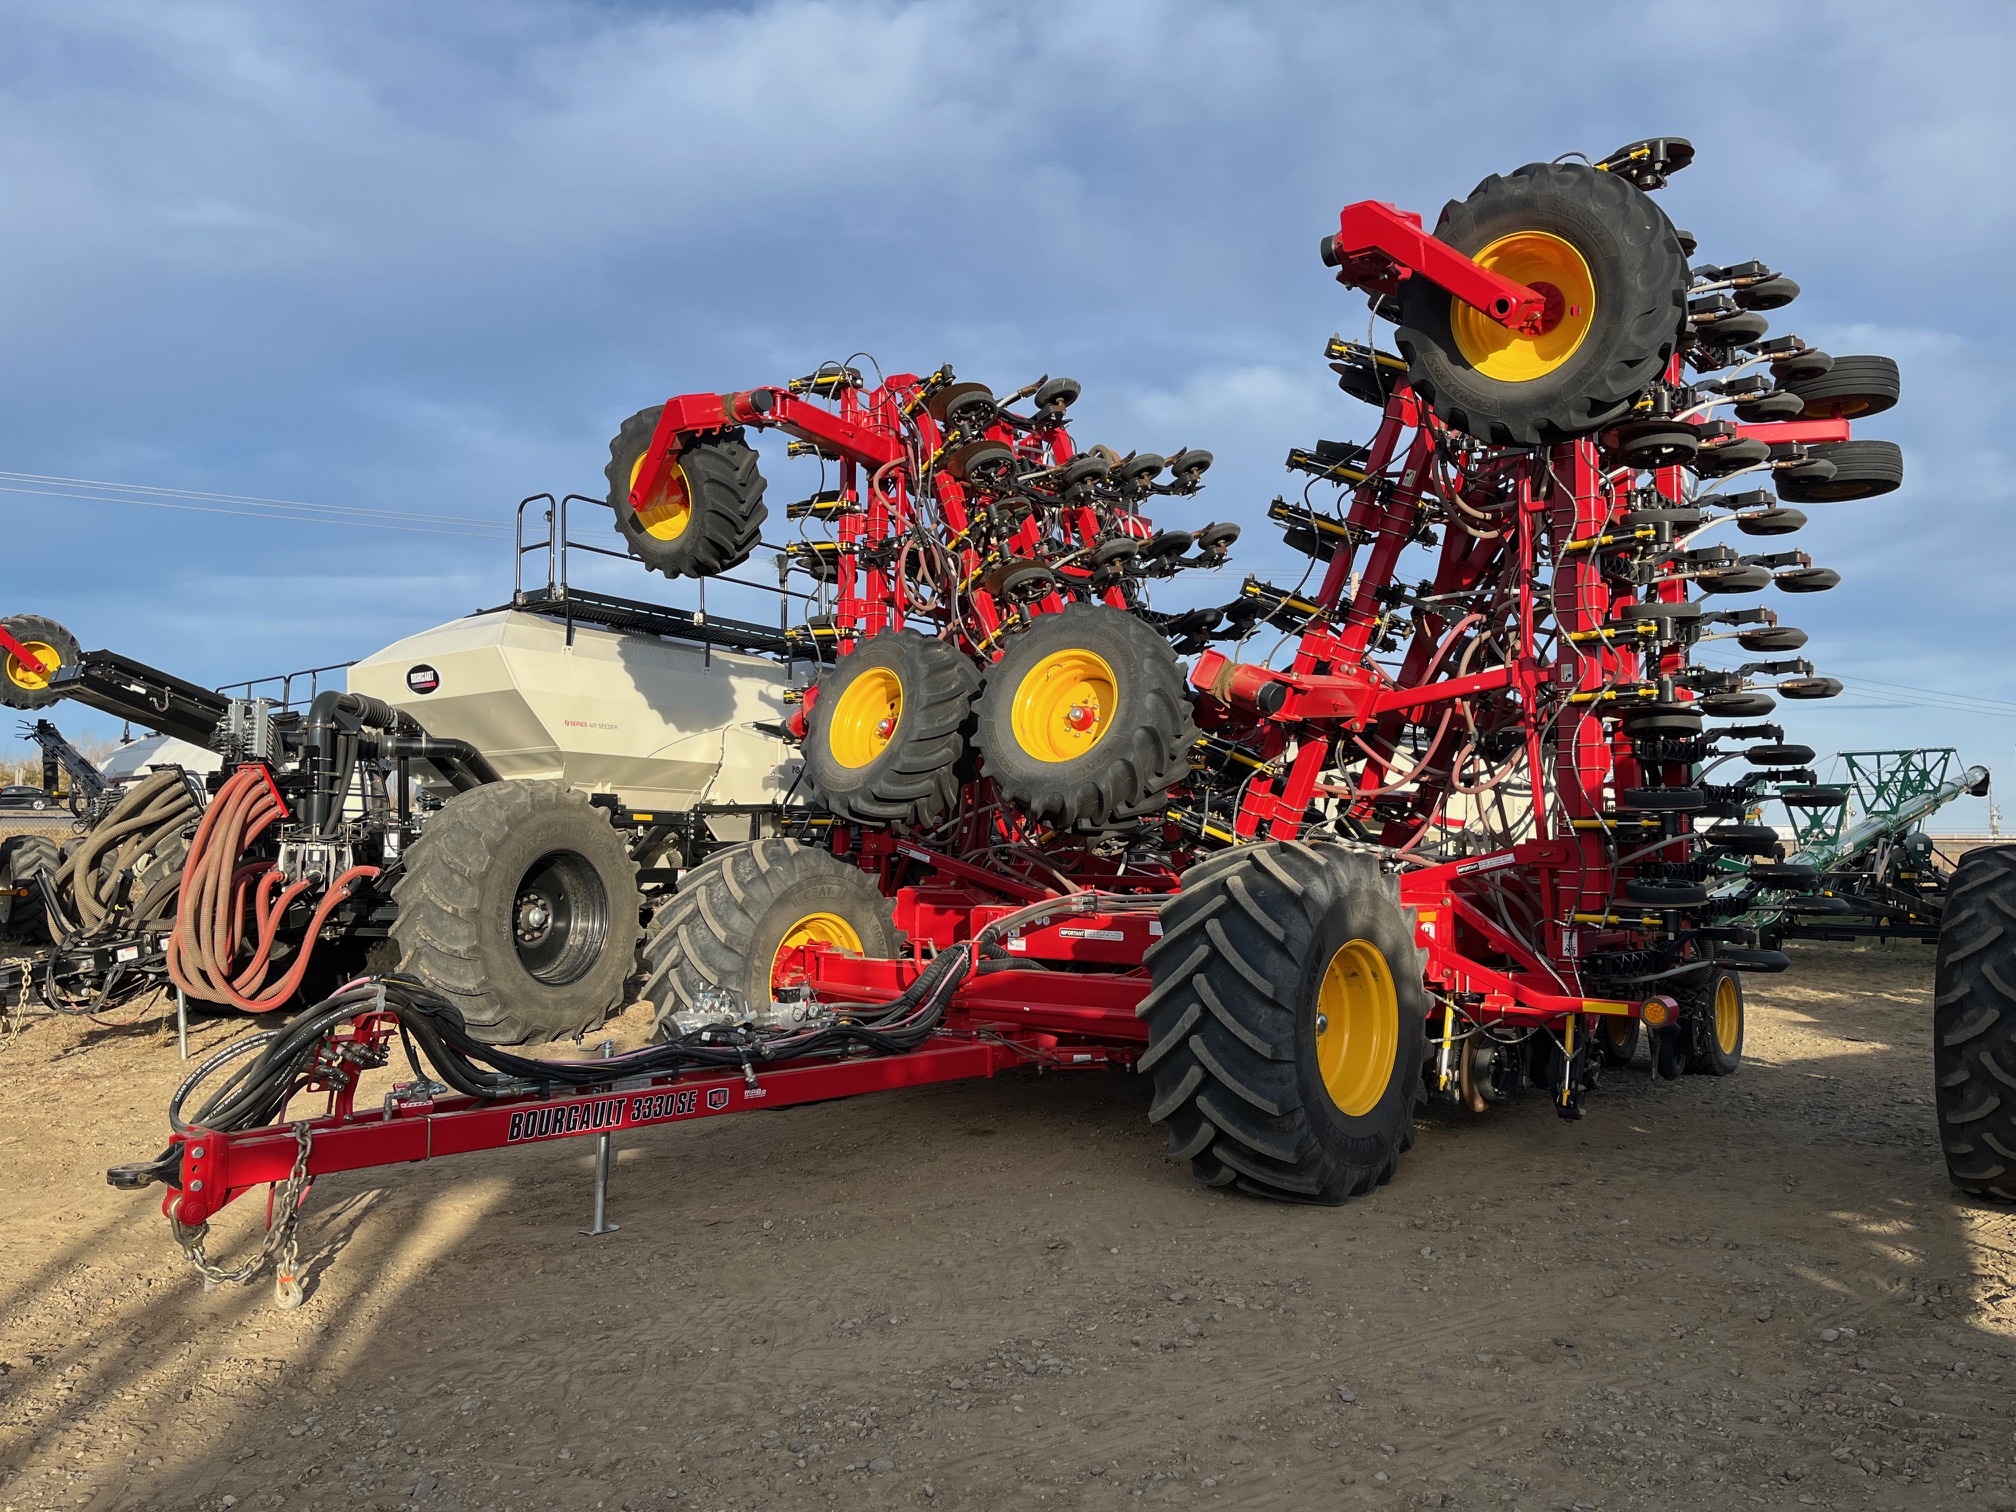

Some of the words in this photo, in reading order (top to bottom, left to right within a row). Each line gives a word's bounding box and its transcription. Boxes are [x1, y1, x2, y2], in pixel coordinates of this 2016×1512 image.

[1444, 381, 1494, 412] FARMAX
[570, 720, 588, 728] SERIES
[598, 723, 618, 731] SEEDER
[803, 884, 834, 899] CEAT
[1061, 929, 1084, 937] IMPORTANT
[507, 1098, 627, 1142] BOURGAULT
